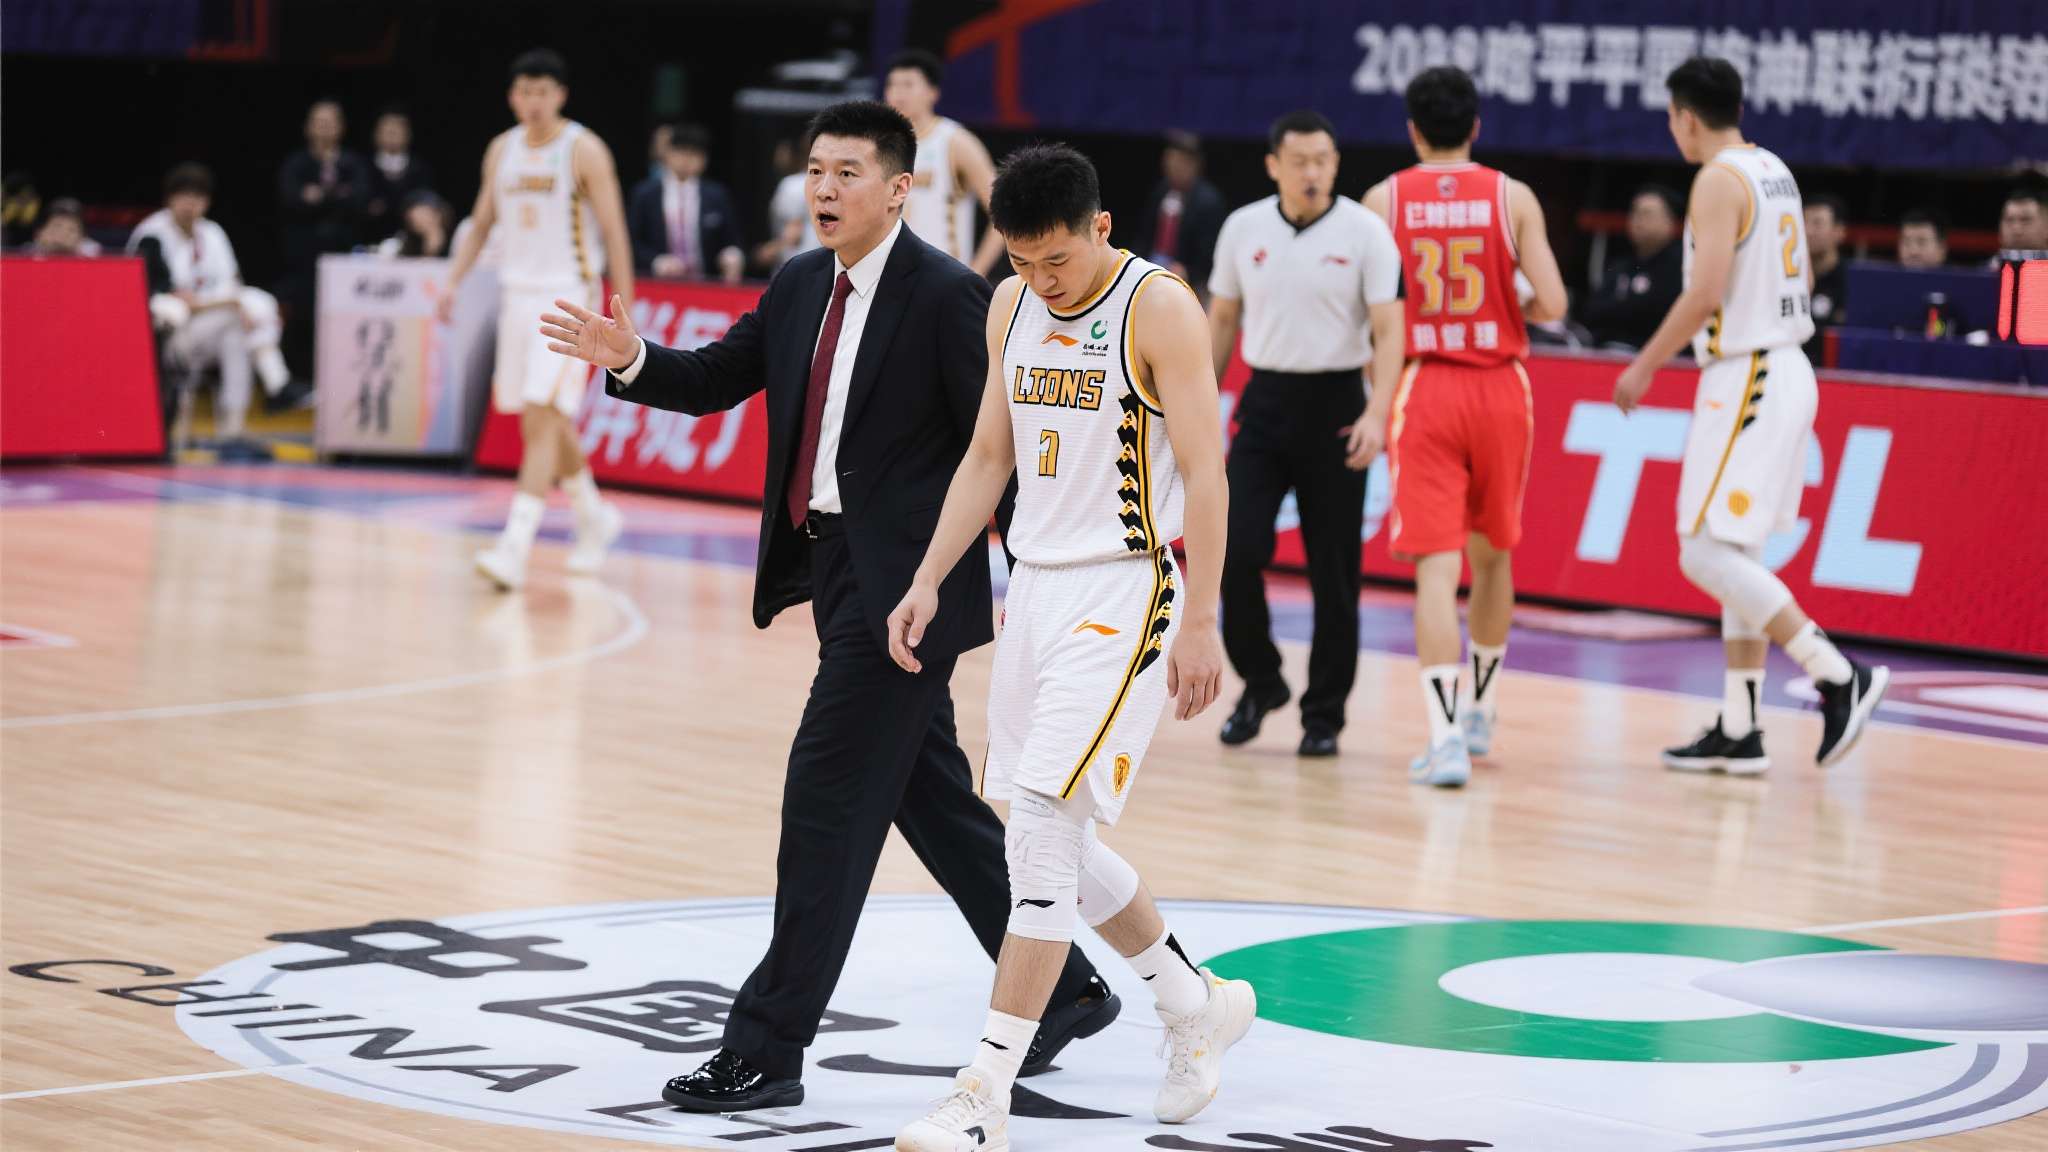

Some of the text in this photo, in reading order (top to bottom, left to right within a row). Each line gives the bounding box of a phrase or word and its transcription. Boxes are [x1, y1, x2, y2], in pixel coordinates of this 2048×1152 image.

[1411, 236, 1485, 317] 35
[1779, 212, 1801, 279] 2
[1012, 365, 1107, 411] LIONS
